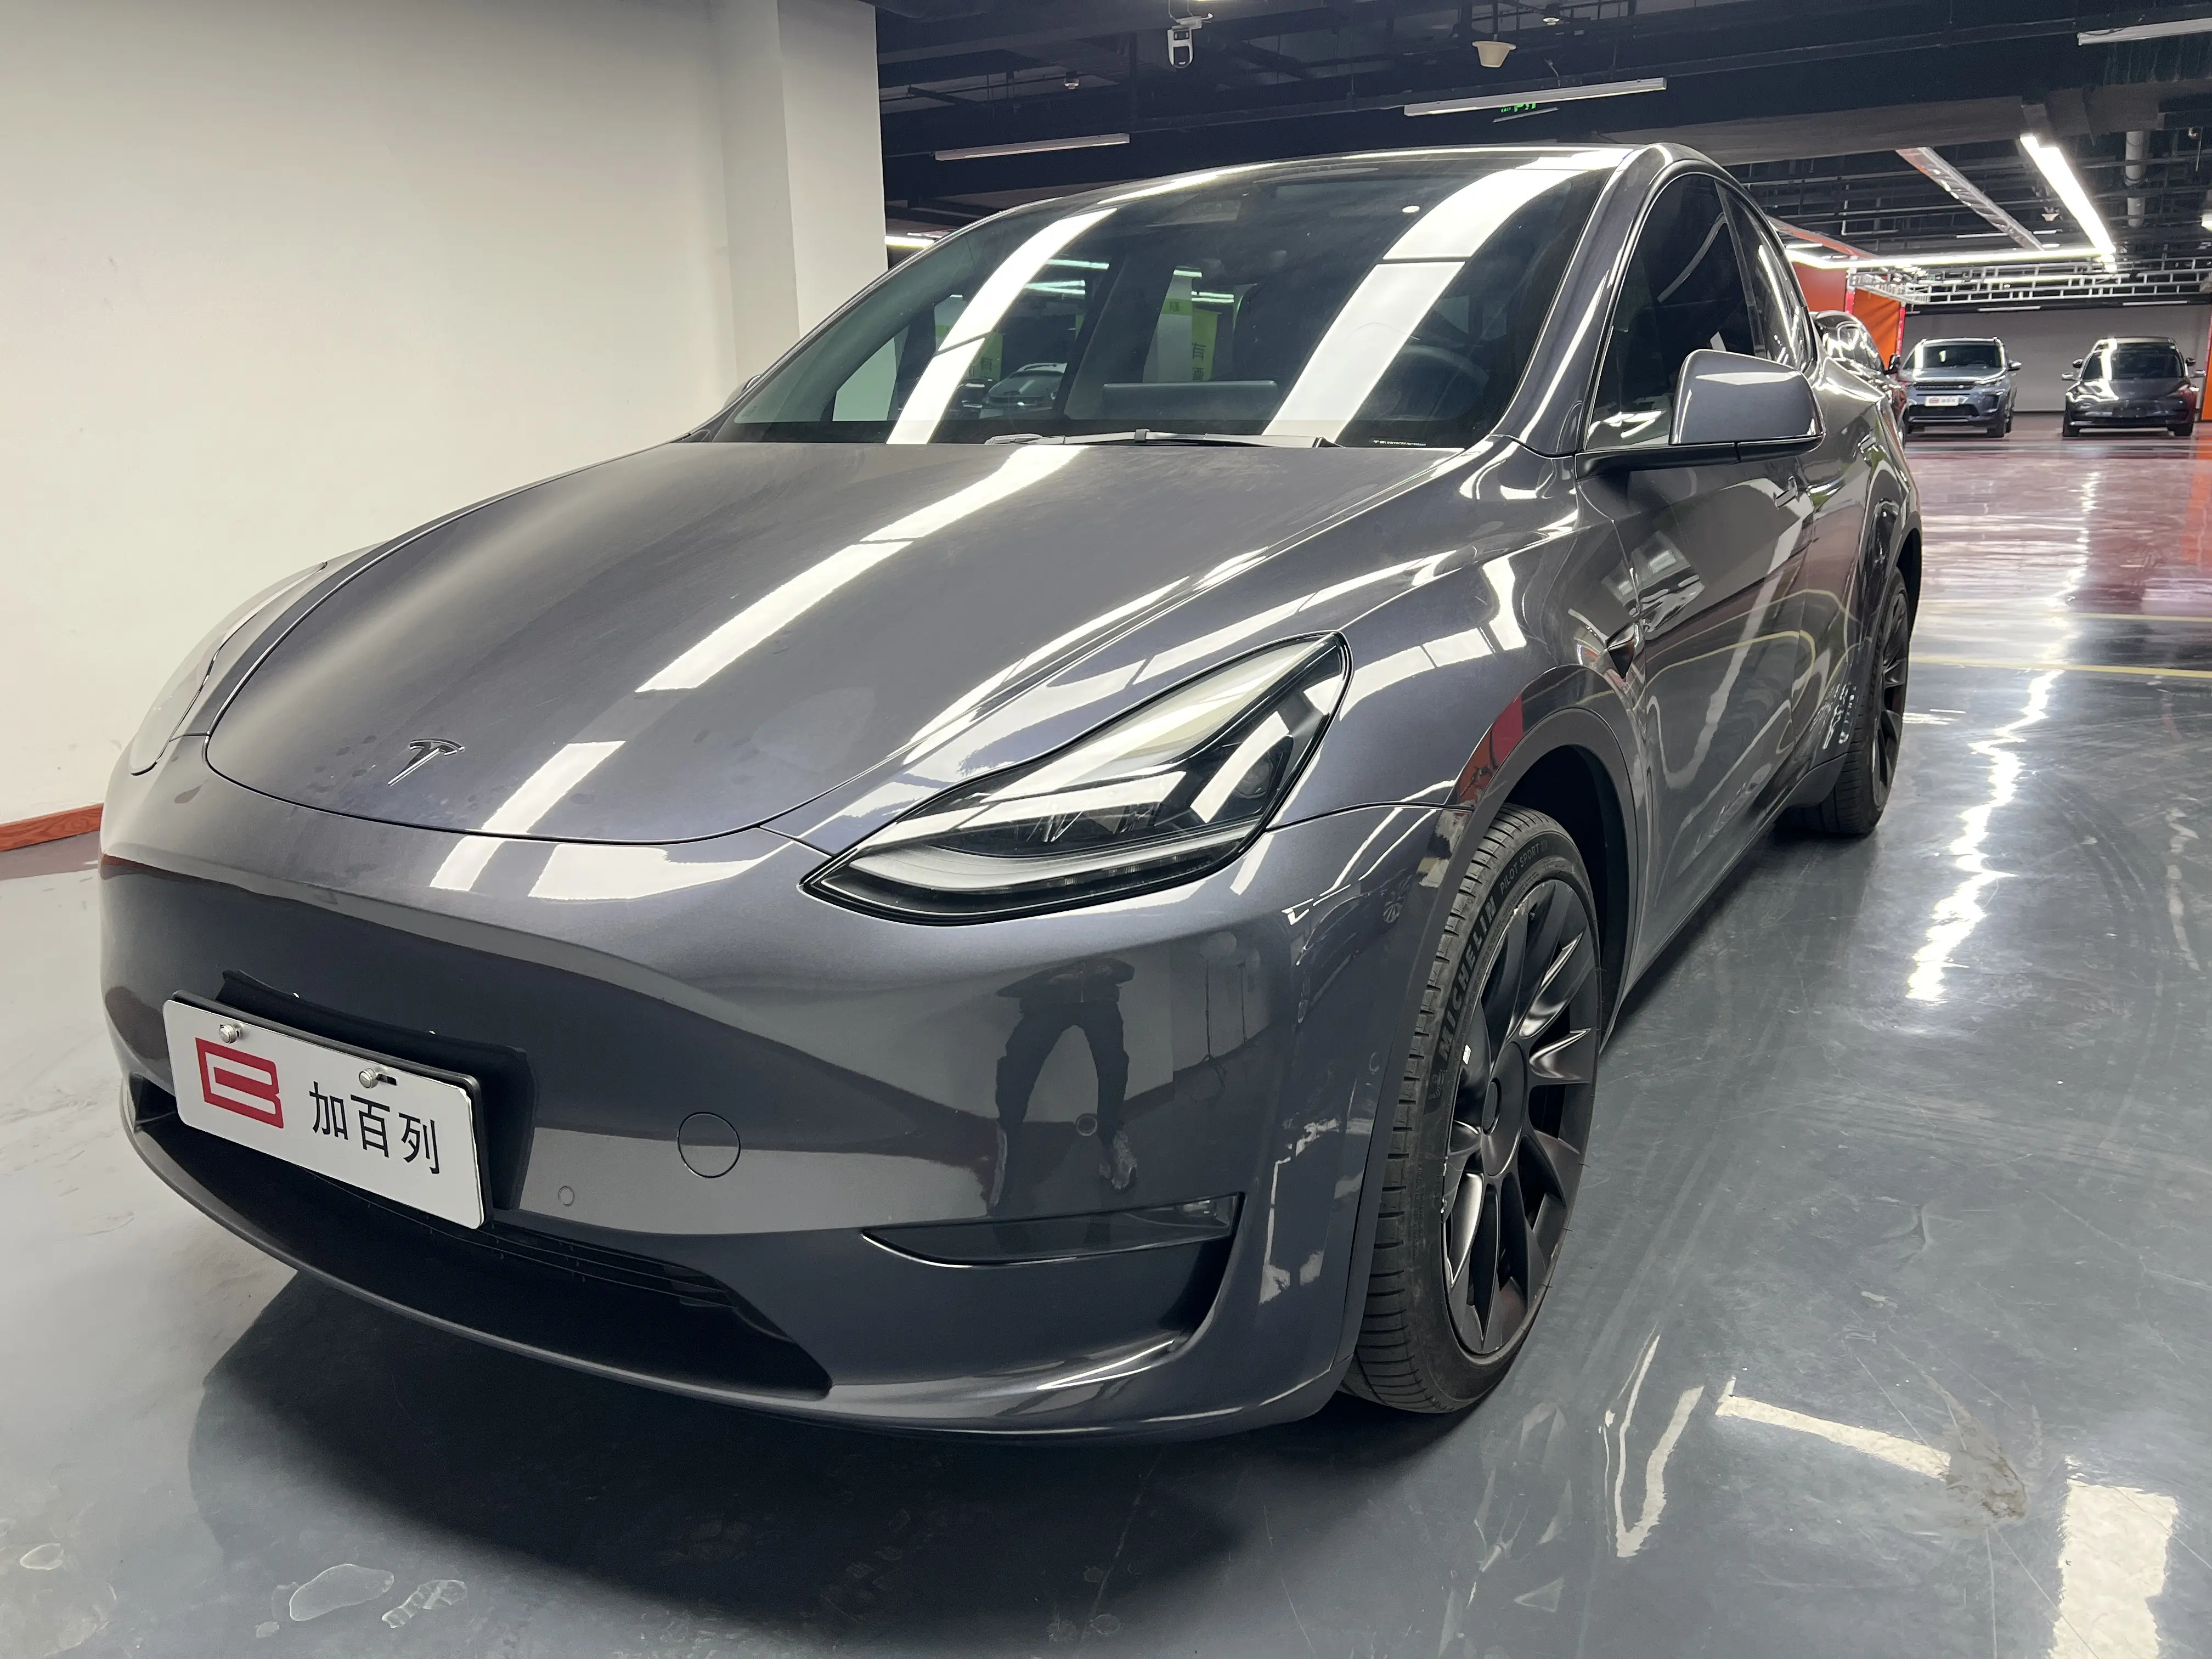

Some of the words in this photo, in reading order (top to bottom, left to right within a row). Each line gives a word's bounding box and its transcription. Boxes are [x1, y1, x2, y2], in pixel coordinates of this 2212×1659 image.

[1500, 862, 1518, 895] PILOT
[1520, 843, 1539, 867] SPORT
[1438, 895, 1497, 1062] MICHELIN
[309, 1081, 440, 1175] 加百列
